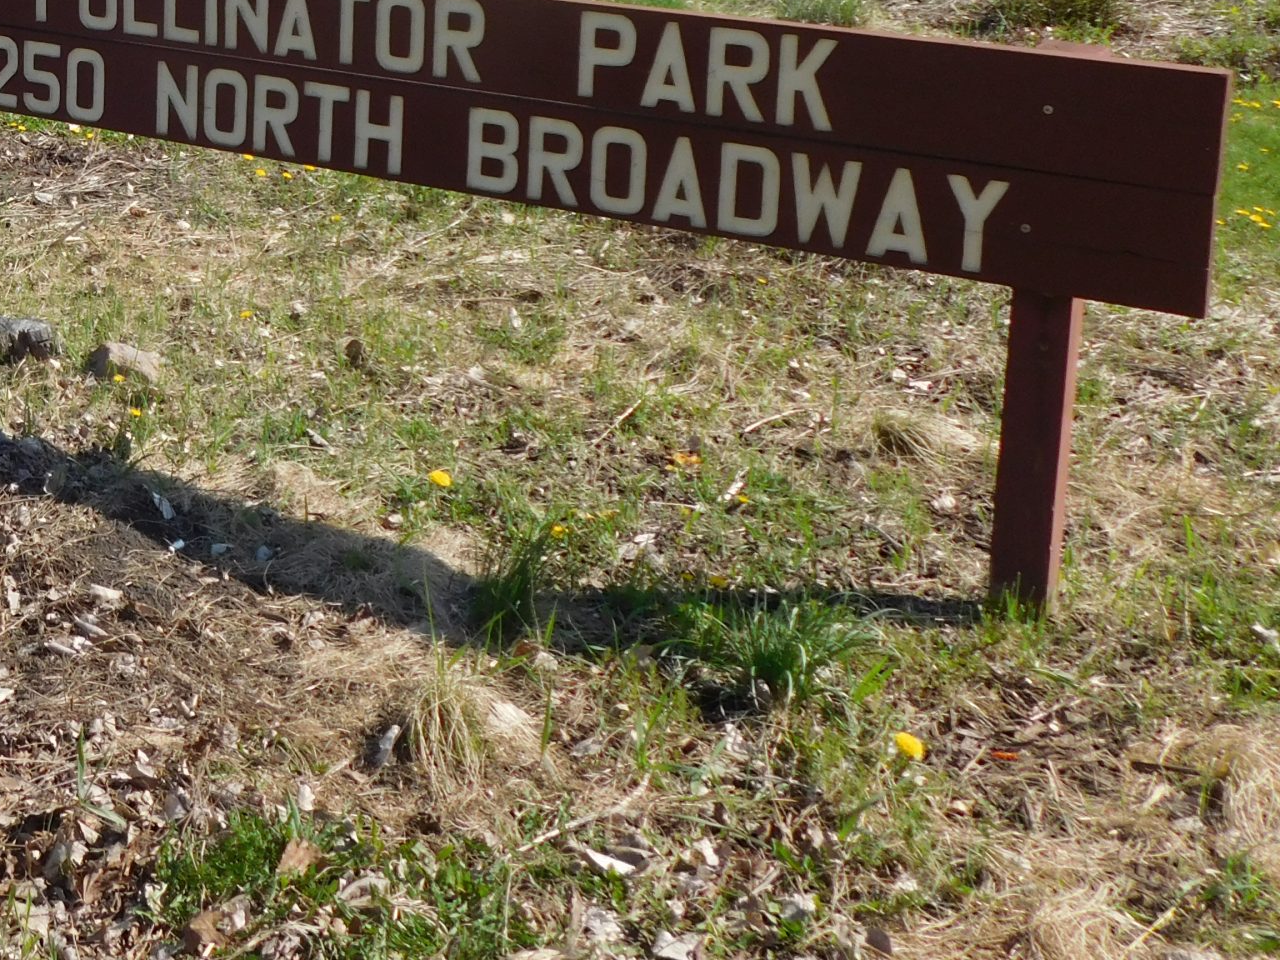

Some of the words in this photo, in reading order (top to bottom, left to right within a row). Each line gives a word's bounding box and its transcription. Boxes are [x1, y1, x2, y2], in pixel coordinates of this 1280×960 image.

[577, 11, 838, 131] PARK
[157, 60, 404, 174] NORTH
[465, 107, 1009, 272] BROADWAY
